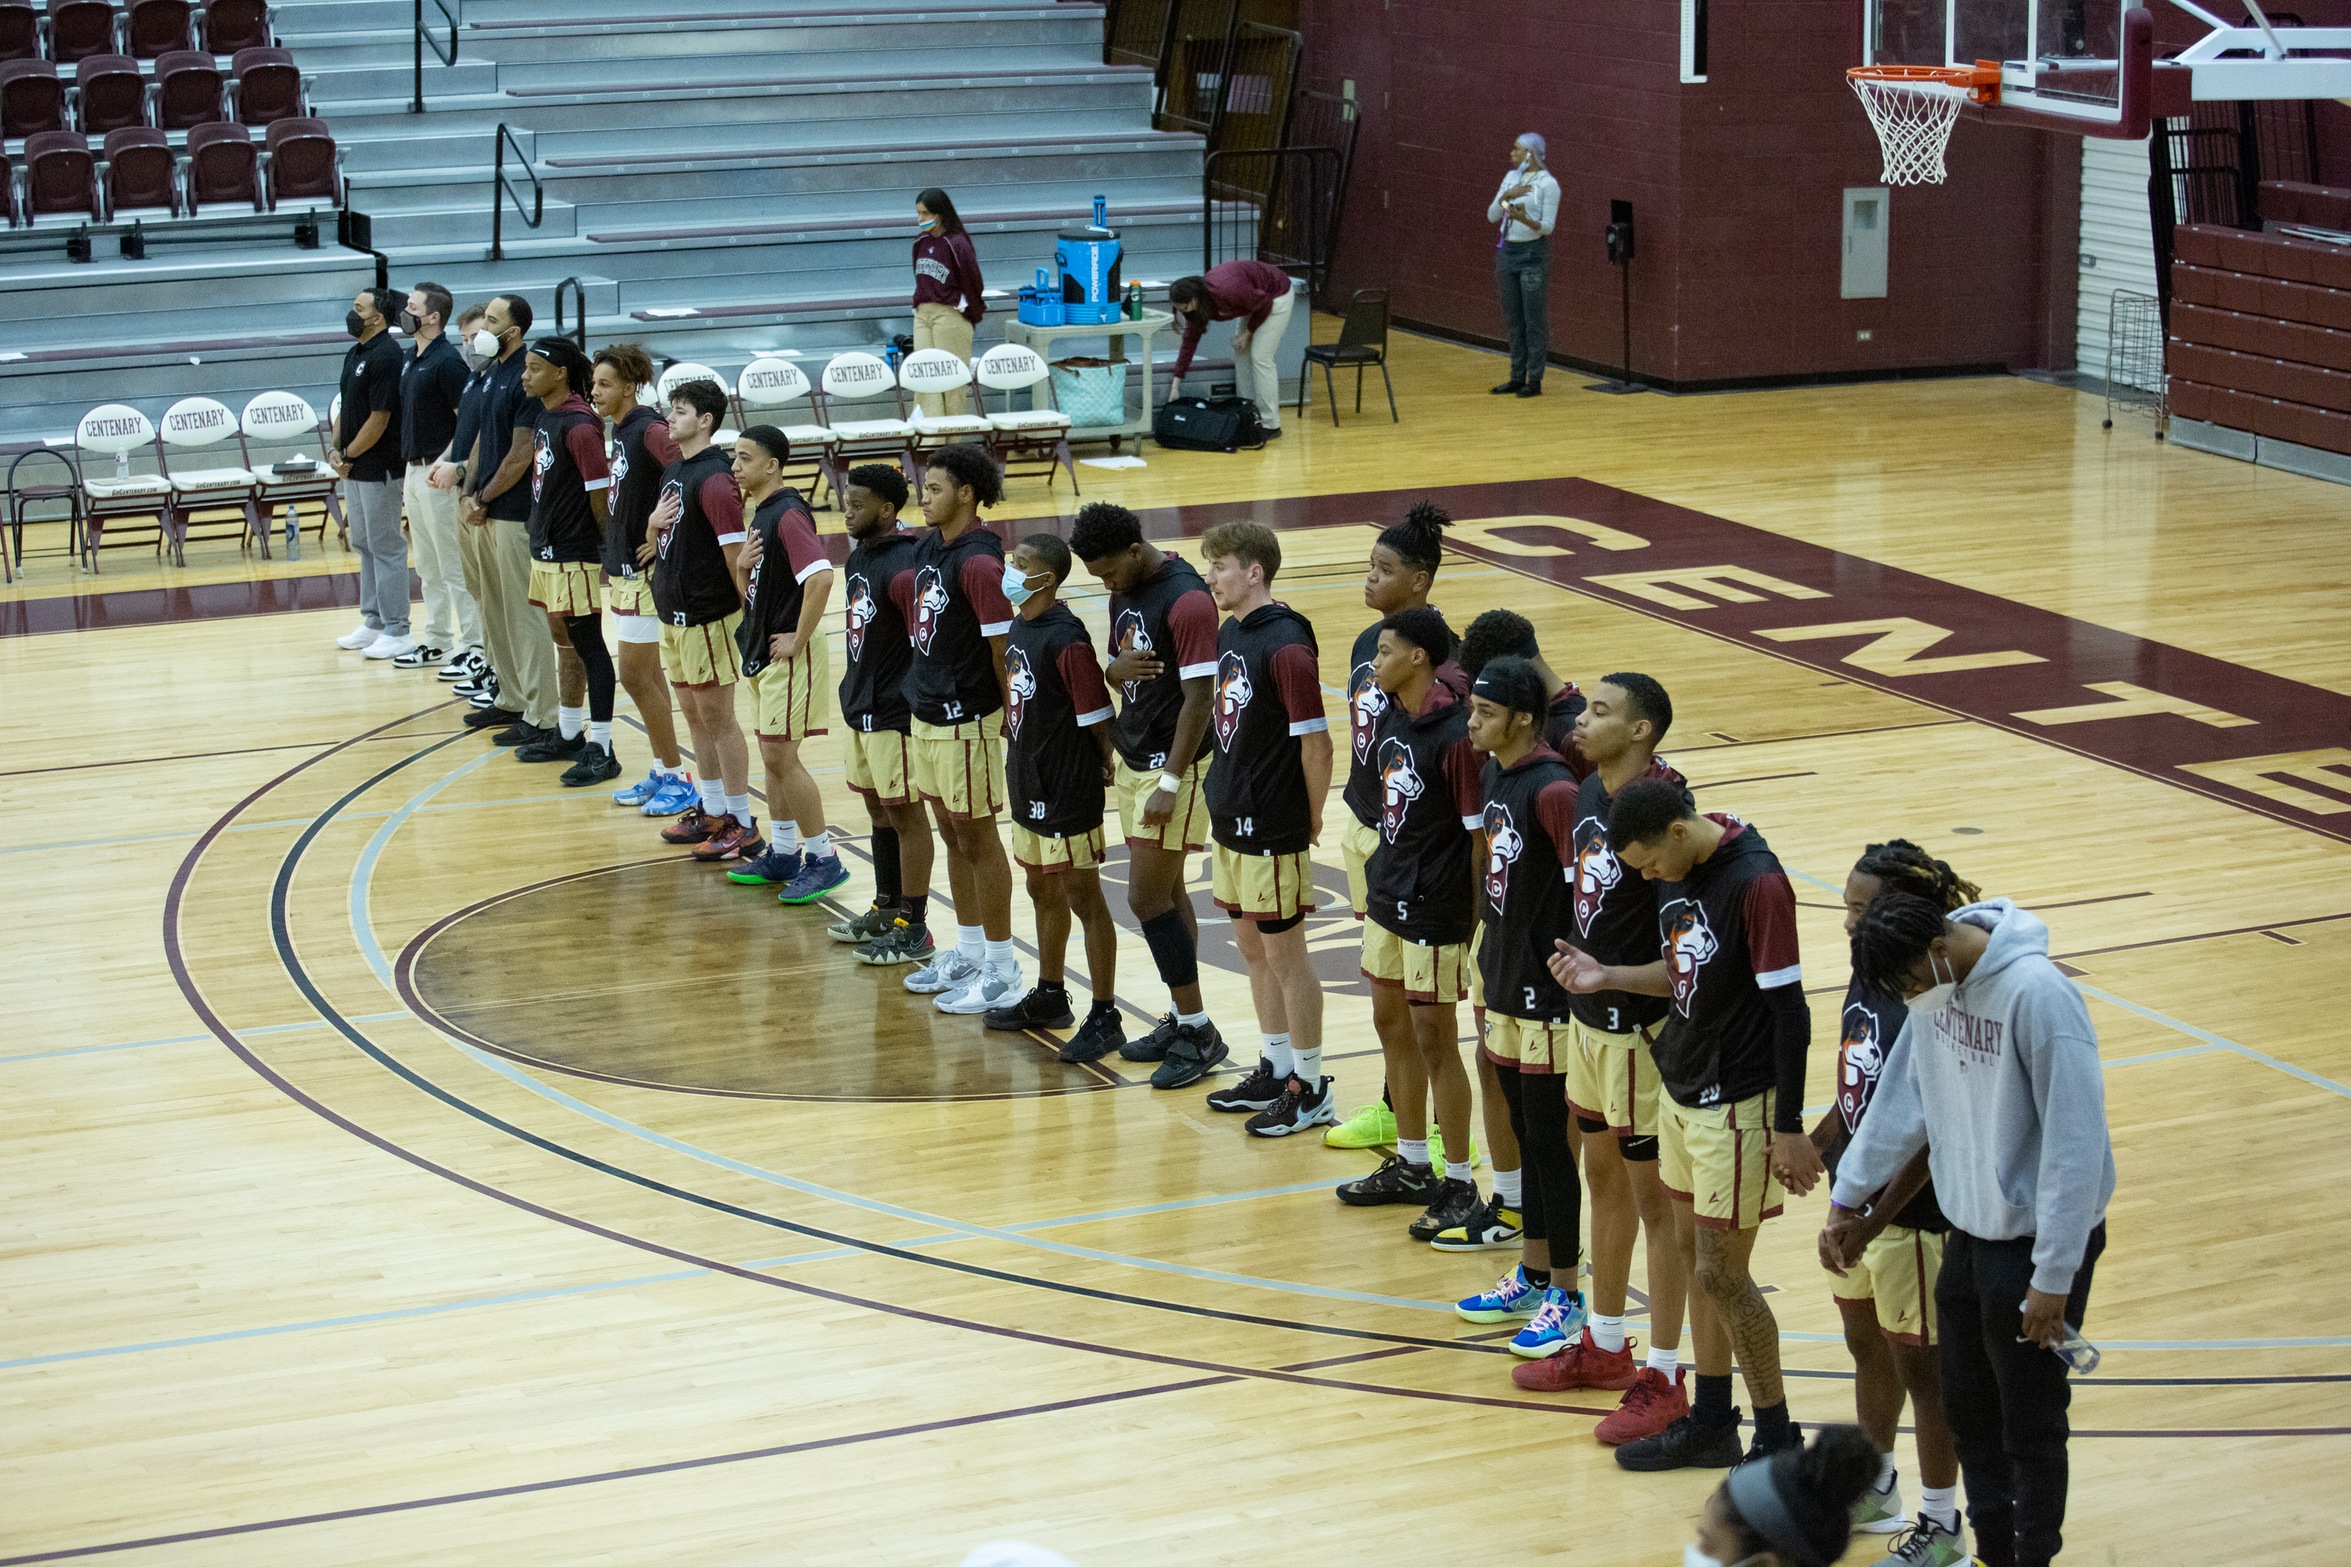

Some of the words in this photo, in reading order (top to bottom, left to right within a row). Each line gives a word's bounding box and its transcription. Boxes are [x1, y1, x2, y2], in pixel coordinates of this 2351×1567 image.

[830, 363, 883, 383] CENTENARY
[906, 360, 959, 379] CENTENARY
[984, 355, 1036, 375] CENTENARY
[746, 369, 798, 389] CENTENARY
[169, 409, 224, 431] CENTENARY
[249, 403, 304, 424] CENTENARY
[85, 417, 141, 437] CENTENARY
[673, 611, 686, 626] 23
[942, 700, 964, 720] 12
[862, 714, 873, 732] 11
[1029, 800, 1046, 820] 30
[1235, 817, 1254, 836] 14
[1397, 901, 1408, 921] 5
[1523, 986, 1536, 1010] 2
[1607, 1007, 1620, 1030] 3
